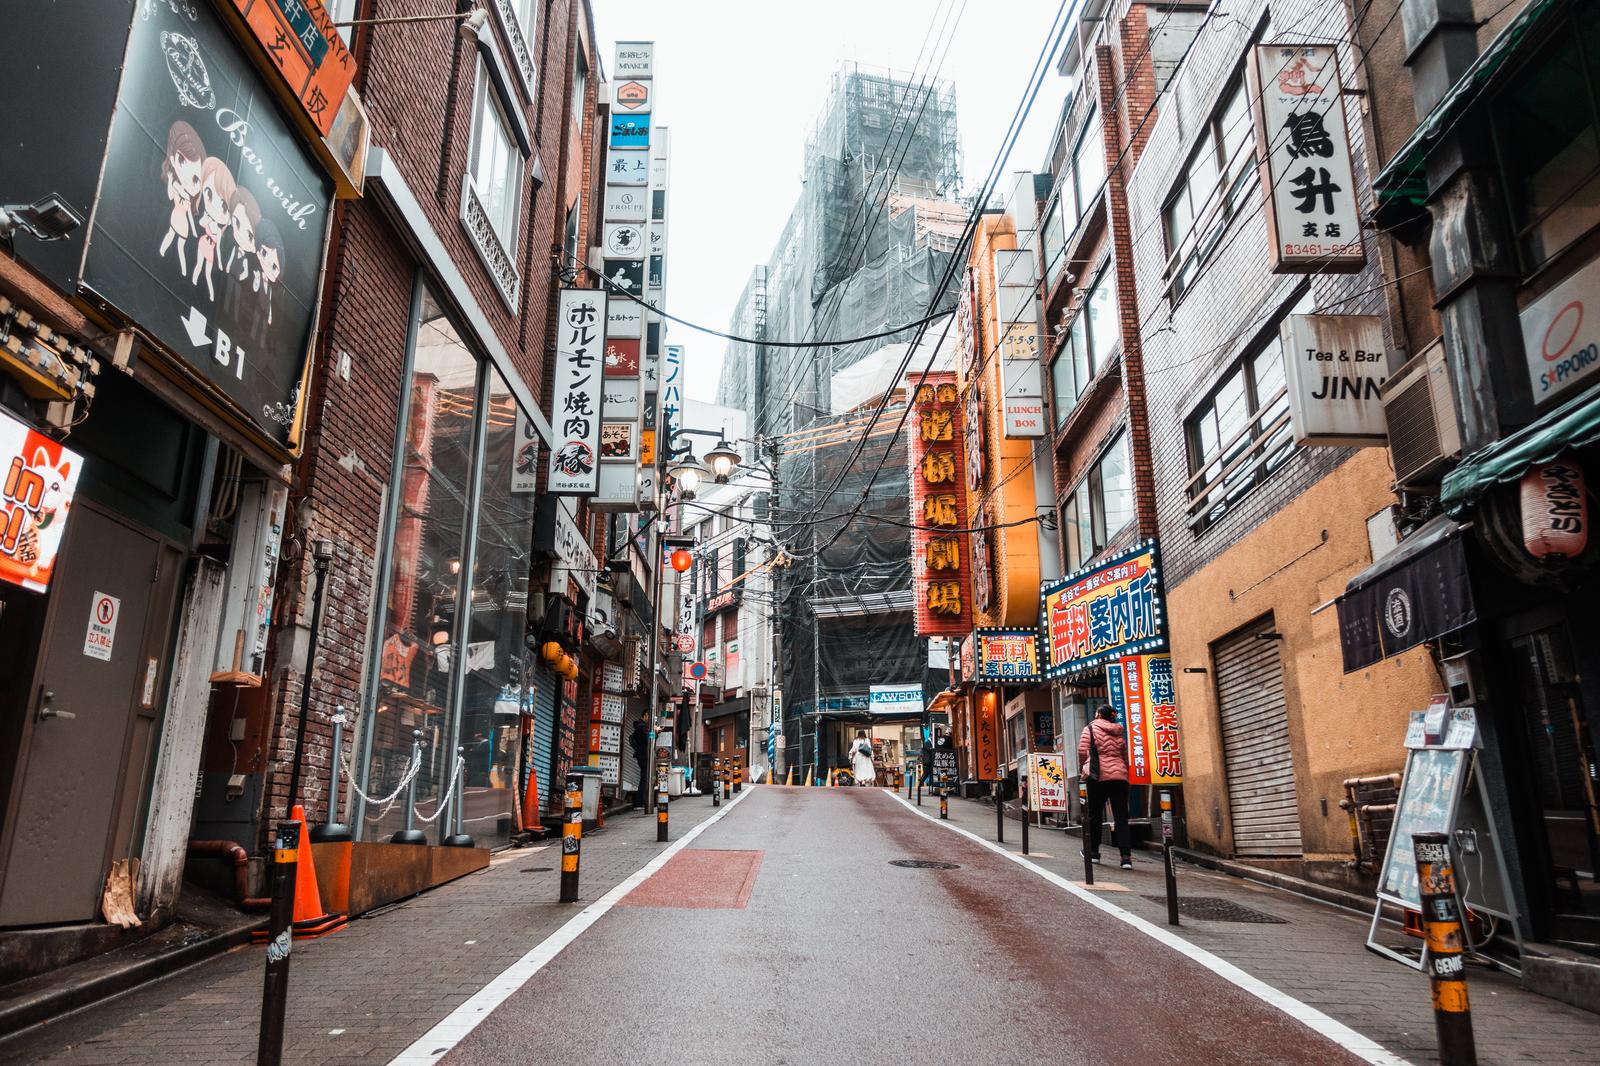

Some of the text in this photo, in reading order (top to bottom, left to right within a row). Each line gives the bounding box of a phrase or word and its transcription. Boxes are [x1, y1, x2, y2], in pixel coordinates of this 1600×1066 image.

[215, 107, 316, 231] Bar with
[612, 158, 646, 173] 最上
[1301, 221, 1342, 239] 支店
[213, 327, 246, 381] B1
[1305, 348, 1383, 364] Tea & Bar
[1007, 405, 1042, 415] LUNCH
[1014, 418, 1037, 428] BOX
[602, 430, 629, 440] あそこ
[987, 642, 1028, 662] 無料
[985, 661, 1033, 677] 案内所
[872, 691, 921, 702] LAWSON
[980, 719, 993, 775] たちひら
[1434, 954, 1464, 975] GENIE
